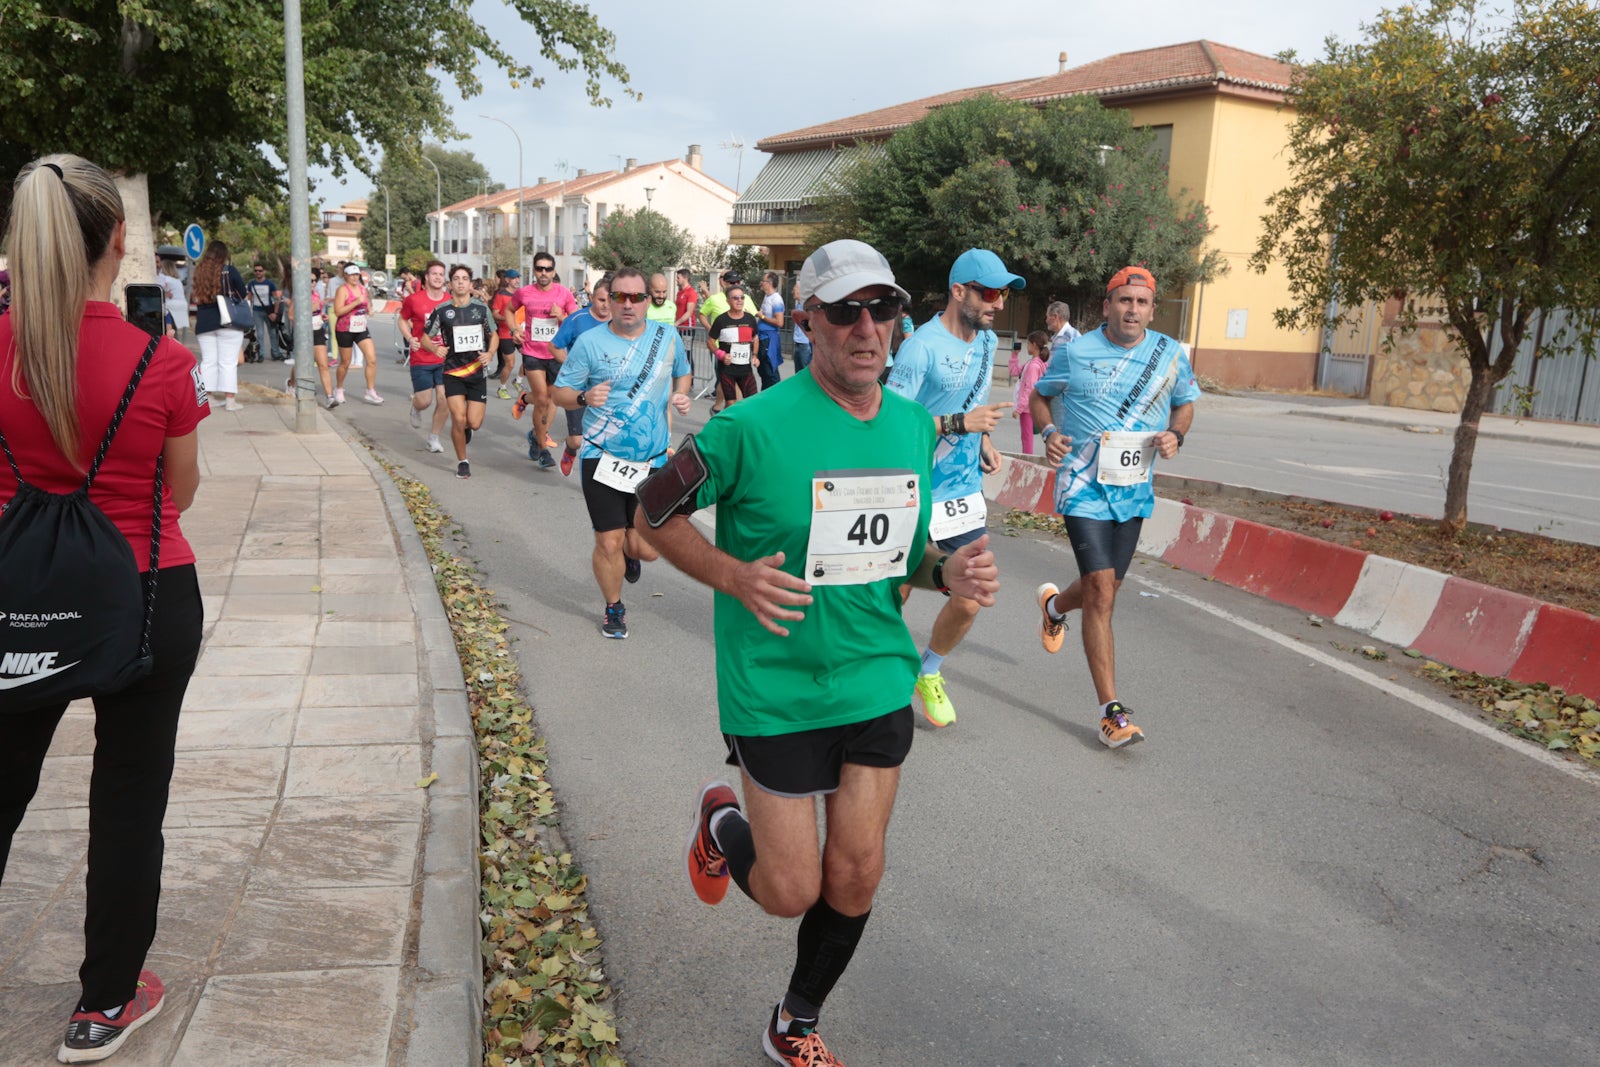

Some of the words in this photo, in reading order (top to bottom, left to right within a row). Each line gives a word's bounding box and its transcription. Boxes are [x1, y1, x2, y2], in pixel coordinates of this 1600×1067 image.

[458, 335, 480, 345] 3137
[534, 327, 556, 336] 3136
[626, 325, 665, 400] WWW.CORTIJOPUERTA.COM
[1116, 335, 1169, 420] WWW.CORTIJOPUERTA.COM
[1120, 450, 1142, 467] 66
[612, 460, 639, 480] 147
[944, 498, 969, 517] 85
[847, 513, 890, 546] 40
[9, 612, 40, 621] RAFA
[41, 611, 82, 621] NADAL
[0, 651, 59, 675] NIKE
